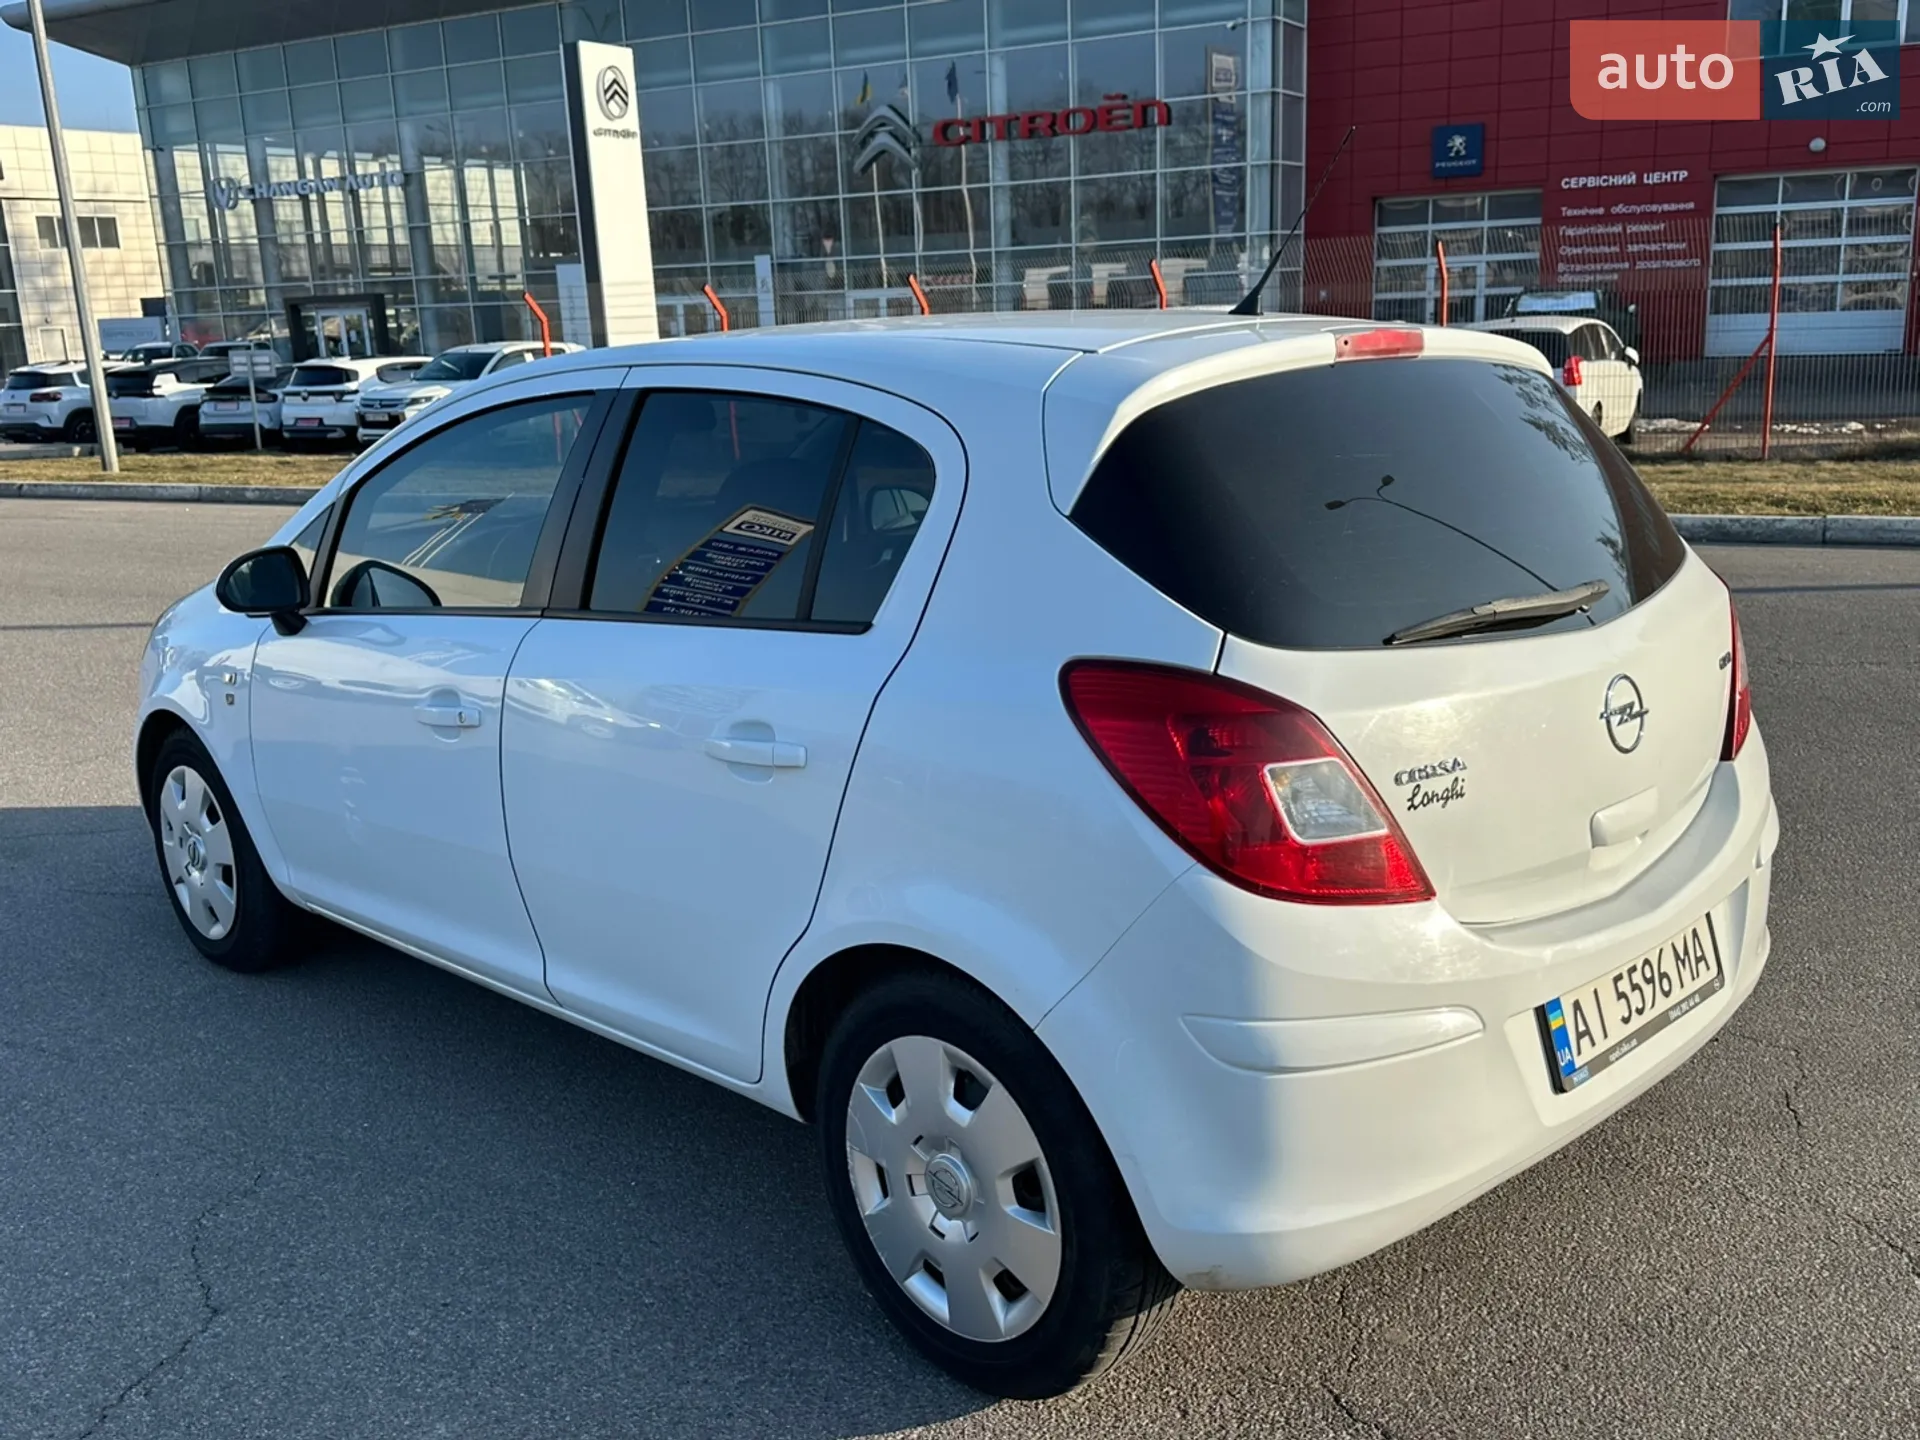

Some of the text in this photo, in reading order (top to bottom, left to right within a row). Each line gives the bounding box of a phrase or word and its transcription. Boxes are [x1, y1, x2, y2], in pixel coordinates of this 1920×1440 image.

[1435, 159, 1477, 168] PEUGEOT
[240, 170, 404, 199] CHANGAN AUTO
[1561, 170, 1688, 189] СЕРВІСНИЙ ЦЕНТР
[1561, 202, 1695, 217] Технічне обслуговування
[1627, 223, 1665, 234] ремонт
[1394, 757, 1467, 787] CORSA
[1407, 776, 1466, 811] Longhi
[1572, 987, 1608, 1056] AI
[1612, 948, 1672, 1025] 5596
[1671, 927, 1711, 989] MA
[1557, 1046, 1572, 1067] UA
